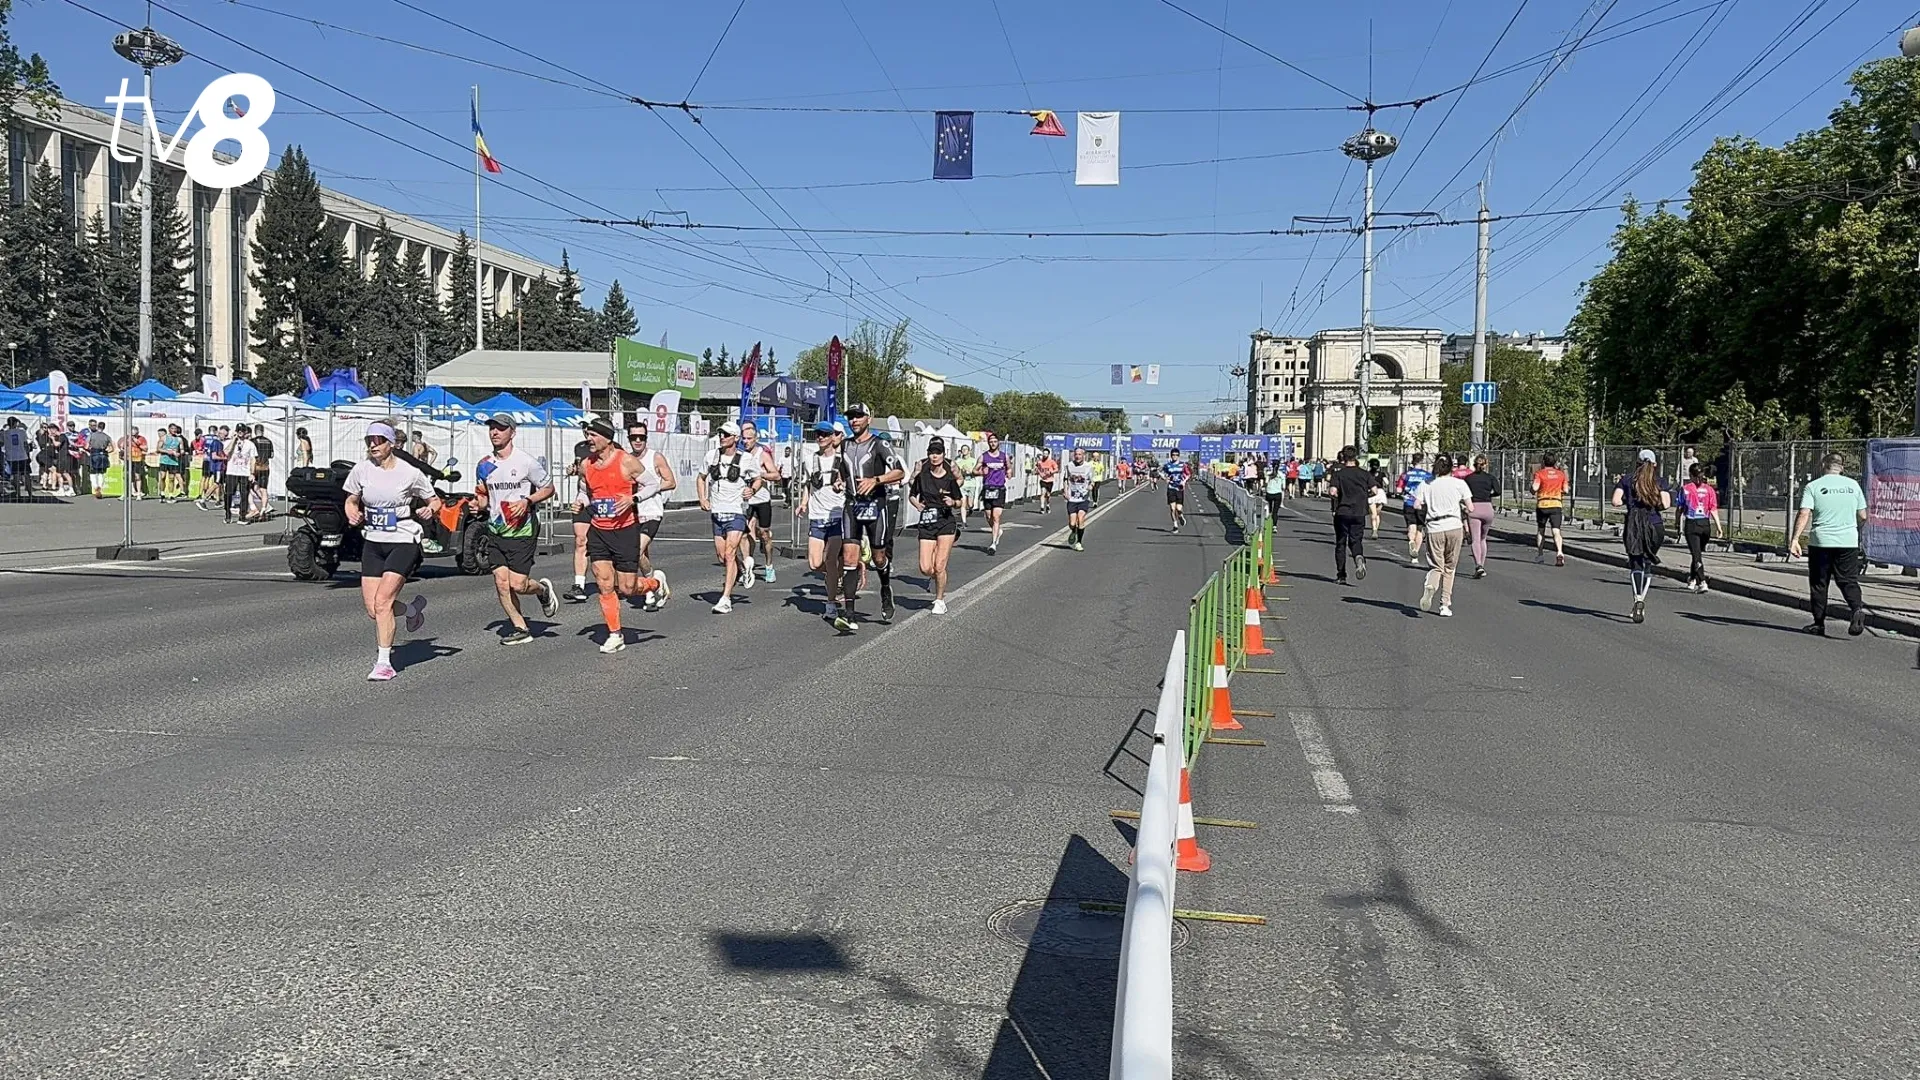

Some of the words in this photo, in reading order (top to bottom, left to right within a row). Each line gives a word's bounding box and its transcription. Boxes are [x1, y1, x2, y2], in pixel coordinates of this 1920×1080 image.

[1073, 437, 1103, 447] FINISH
[1152, 438, 1181, 448] START
[1231, 439, 1260, 449] START
[597, 503, 608, 514] 58
[372, 514, 389, 526] 921
